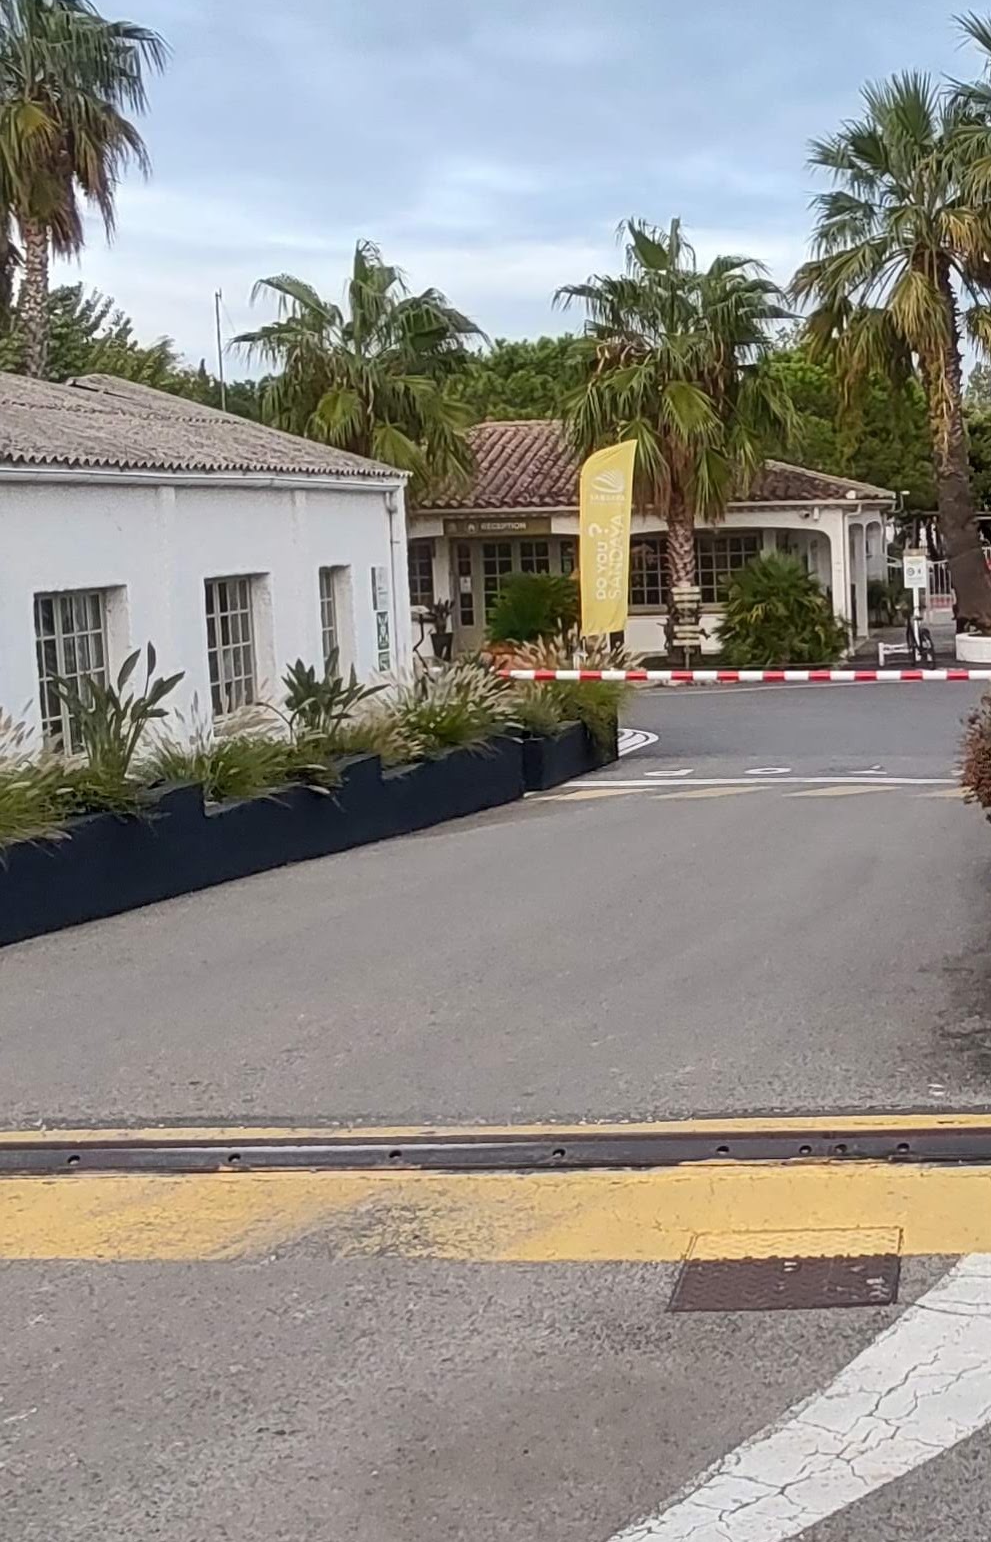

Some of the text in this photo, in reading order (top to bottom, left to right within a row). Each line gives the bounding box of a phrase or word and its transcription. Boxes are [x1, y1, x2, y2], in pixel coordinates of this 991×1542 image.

[597, 541, 608, 571] YOU
[609, 514, 625, 600] SANDAYA
[596, 577, 607, 600] DO
